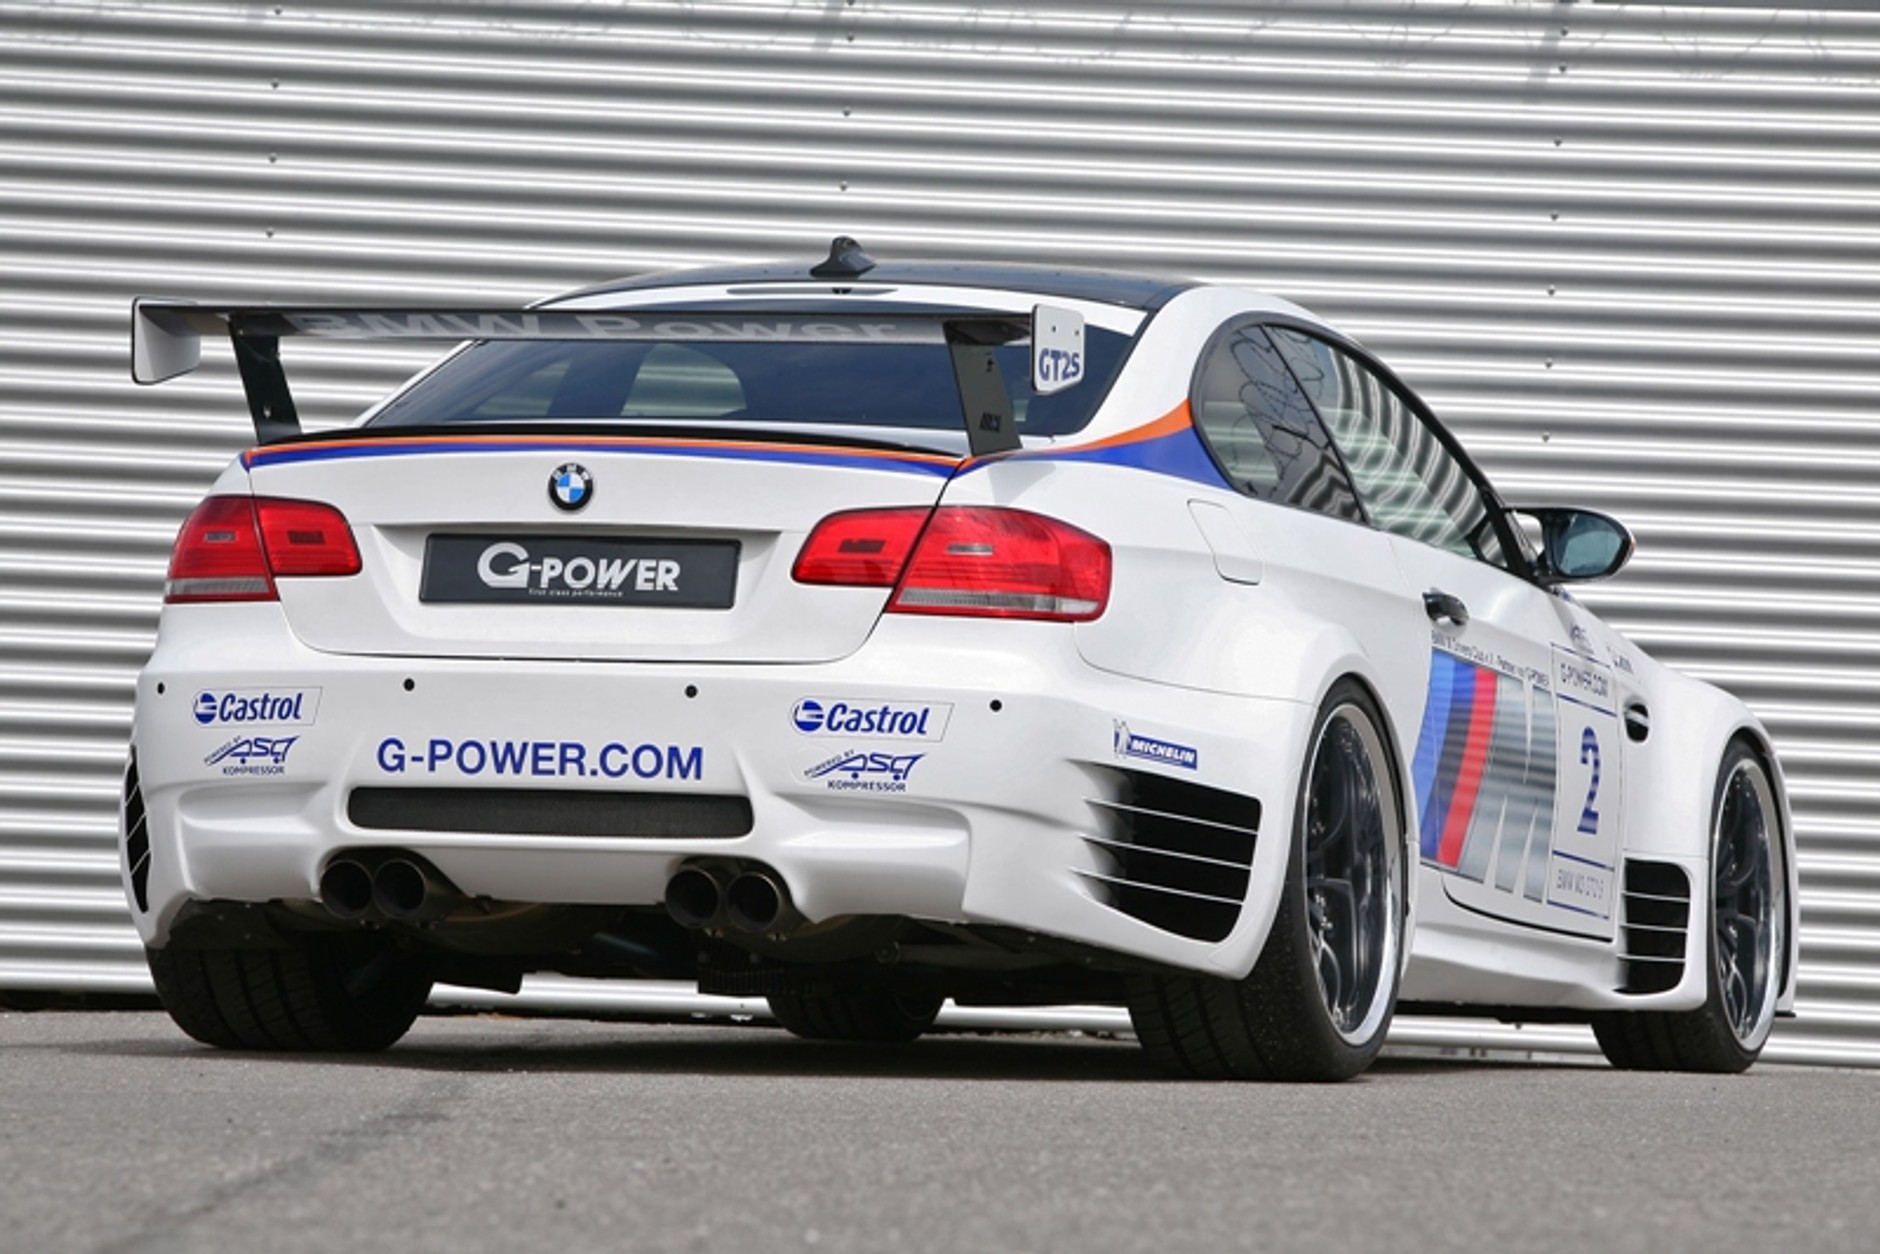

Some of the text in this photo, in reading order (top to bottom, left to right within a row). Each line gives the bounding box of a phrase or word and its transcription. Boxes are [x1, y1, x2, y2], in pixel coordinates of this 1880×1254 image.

[574, 314, 896, 340] Power
[1039, 347, 1081, 382] GT2S
[477, 542, 681, 591] G-POWER
[220, 692, 303, 722] Castrol
[826, 702, 930, 735] Castrol
[377, 737, 704, 781] G-POWER.COM
[1130, 739, 1195, 764] MICHELIN
[222, 765, 286, 776] KOMPRESSOR
[827, 779, 907, 792] KOMPRESSOR
[1576, 725, 1601, 835] 2
